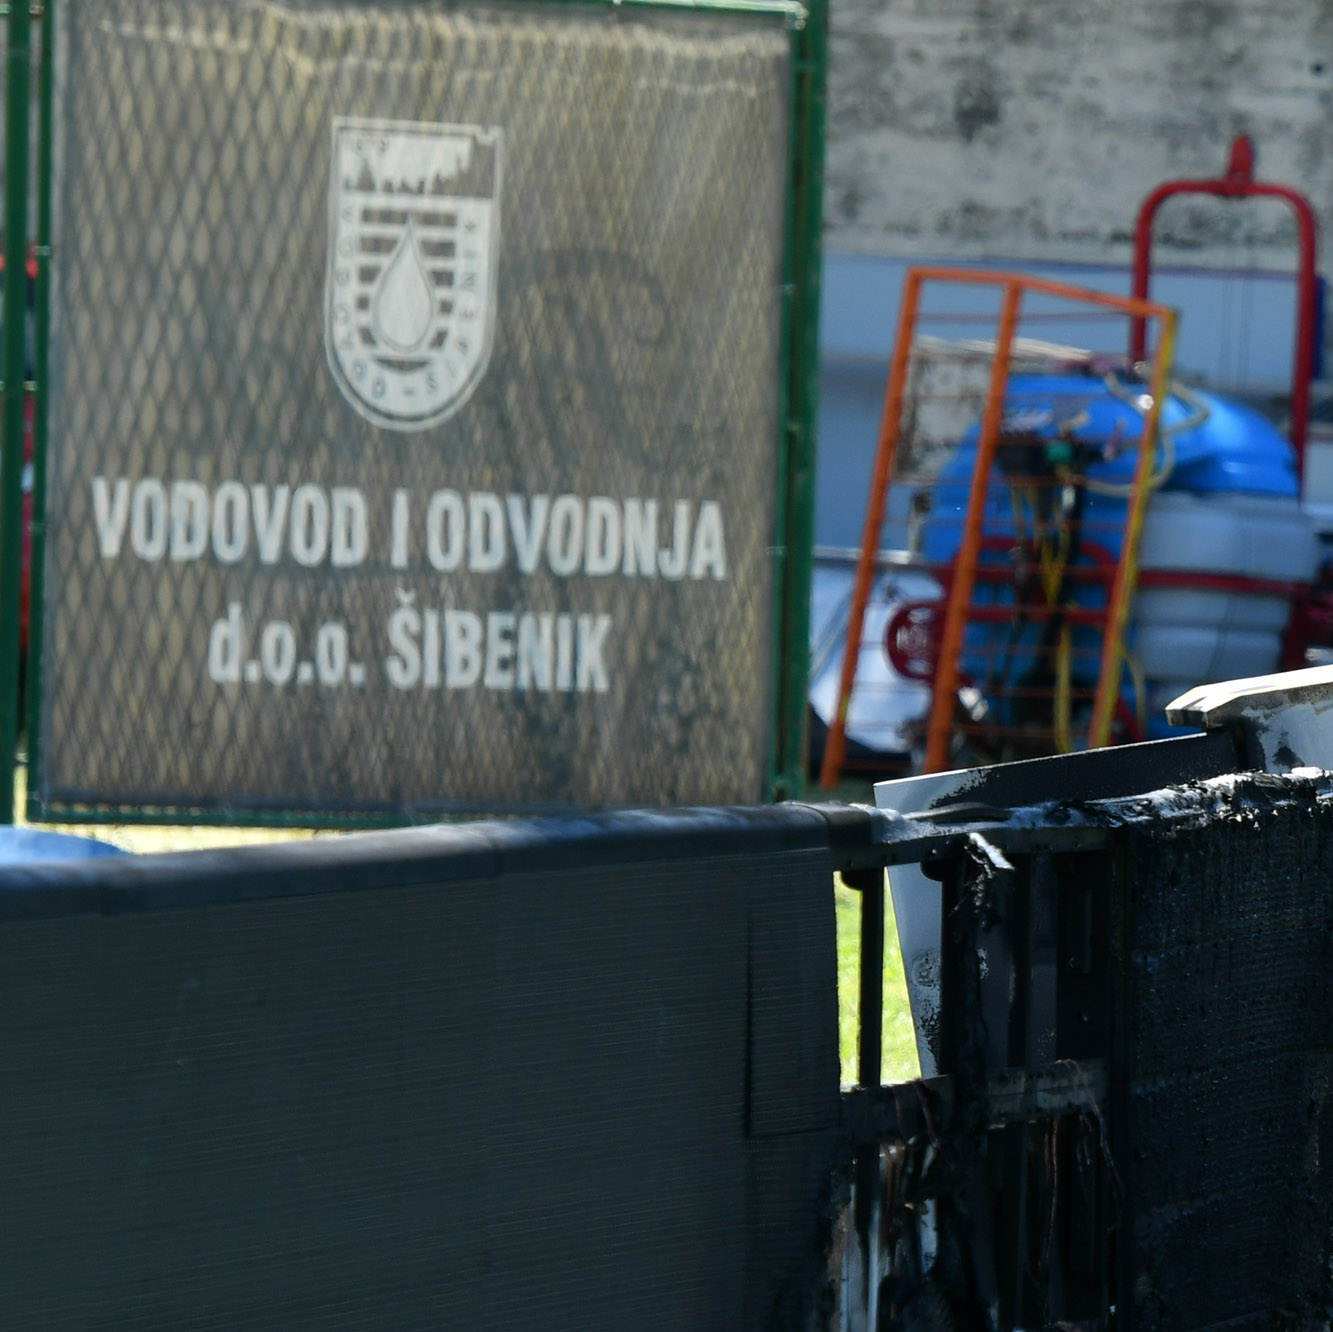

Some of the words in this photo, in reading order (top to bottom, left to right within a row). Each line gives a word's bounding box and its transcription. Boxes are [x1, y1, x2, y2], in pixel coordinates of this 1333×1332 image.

[92, 477, 368, 569] VODOVOD
[391, 490, 406, 567] I
[427, 489, 728, 580] ODVODNJA
[208, 602, 367, 688] d.o.o.
[386, 587, 612, 693] ŠIBENIK
